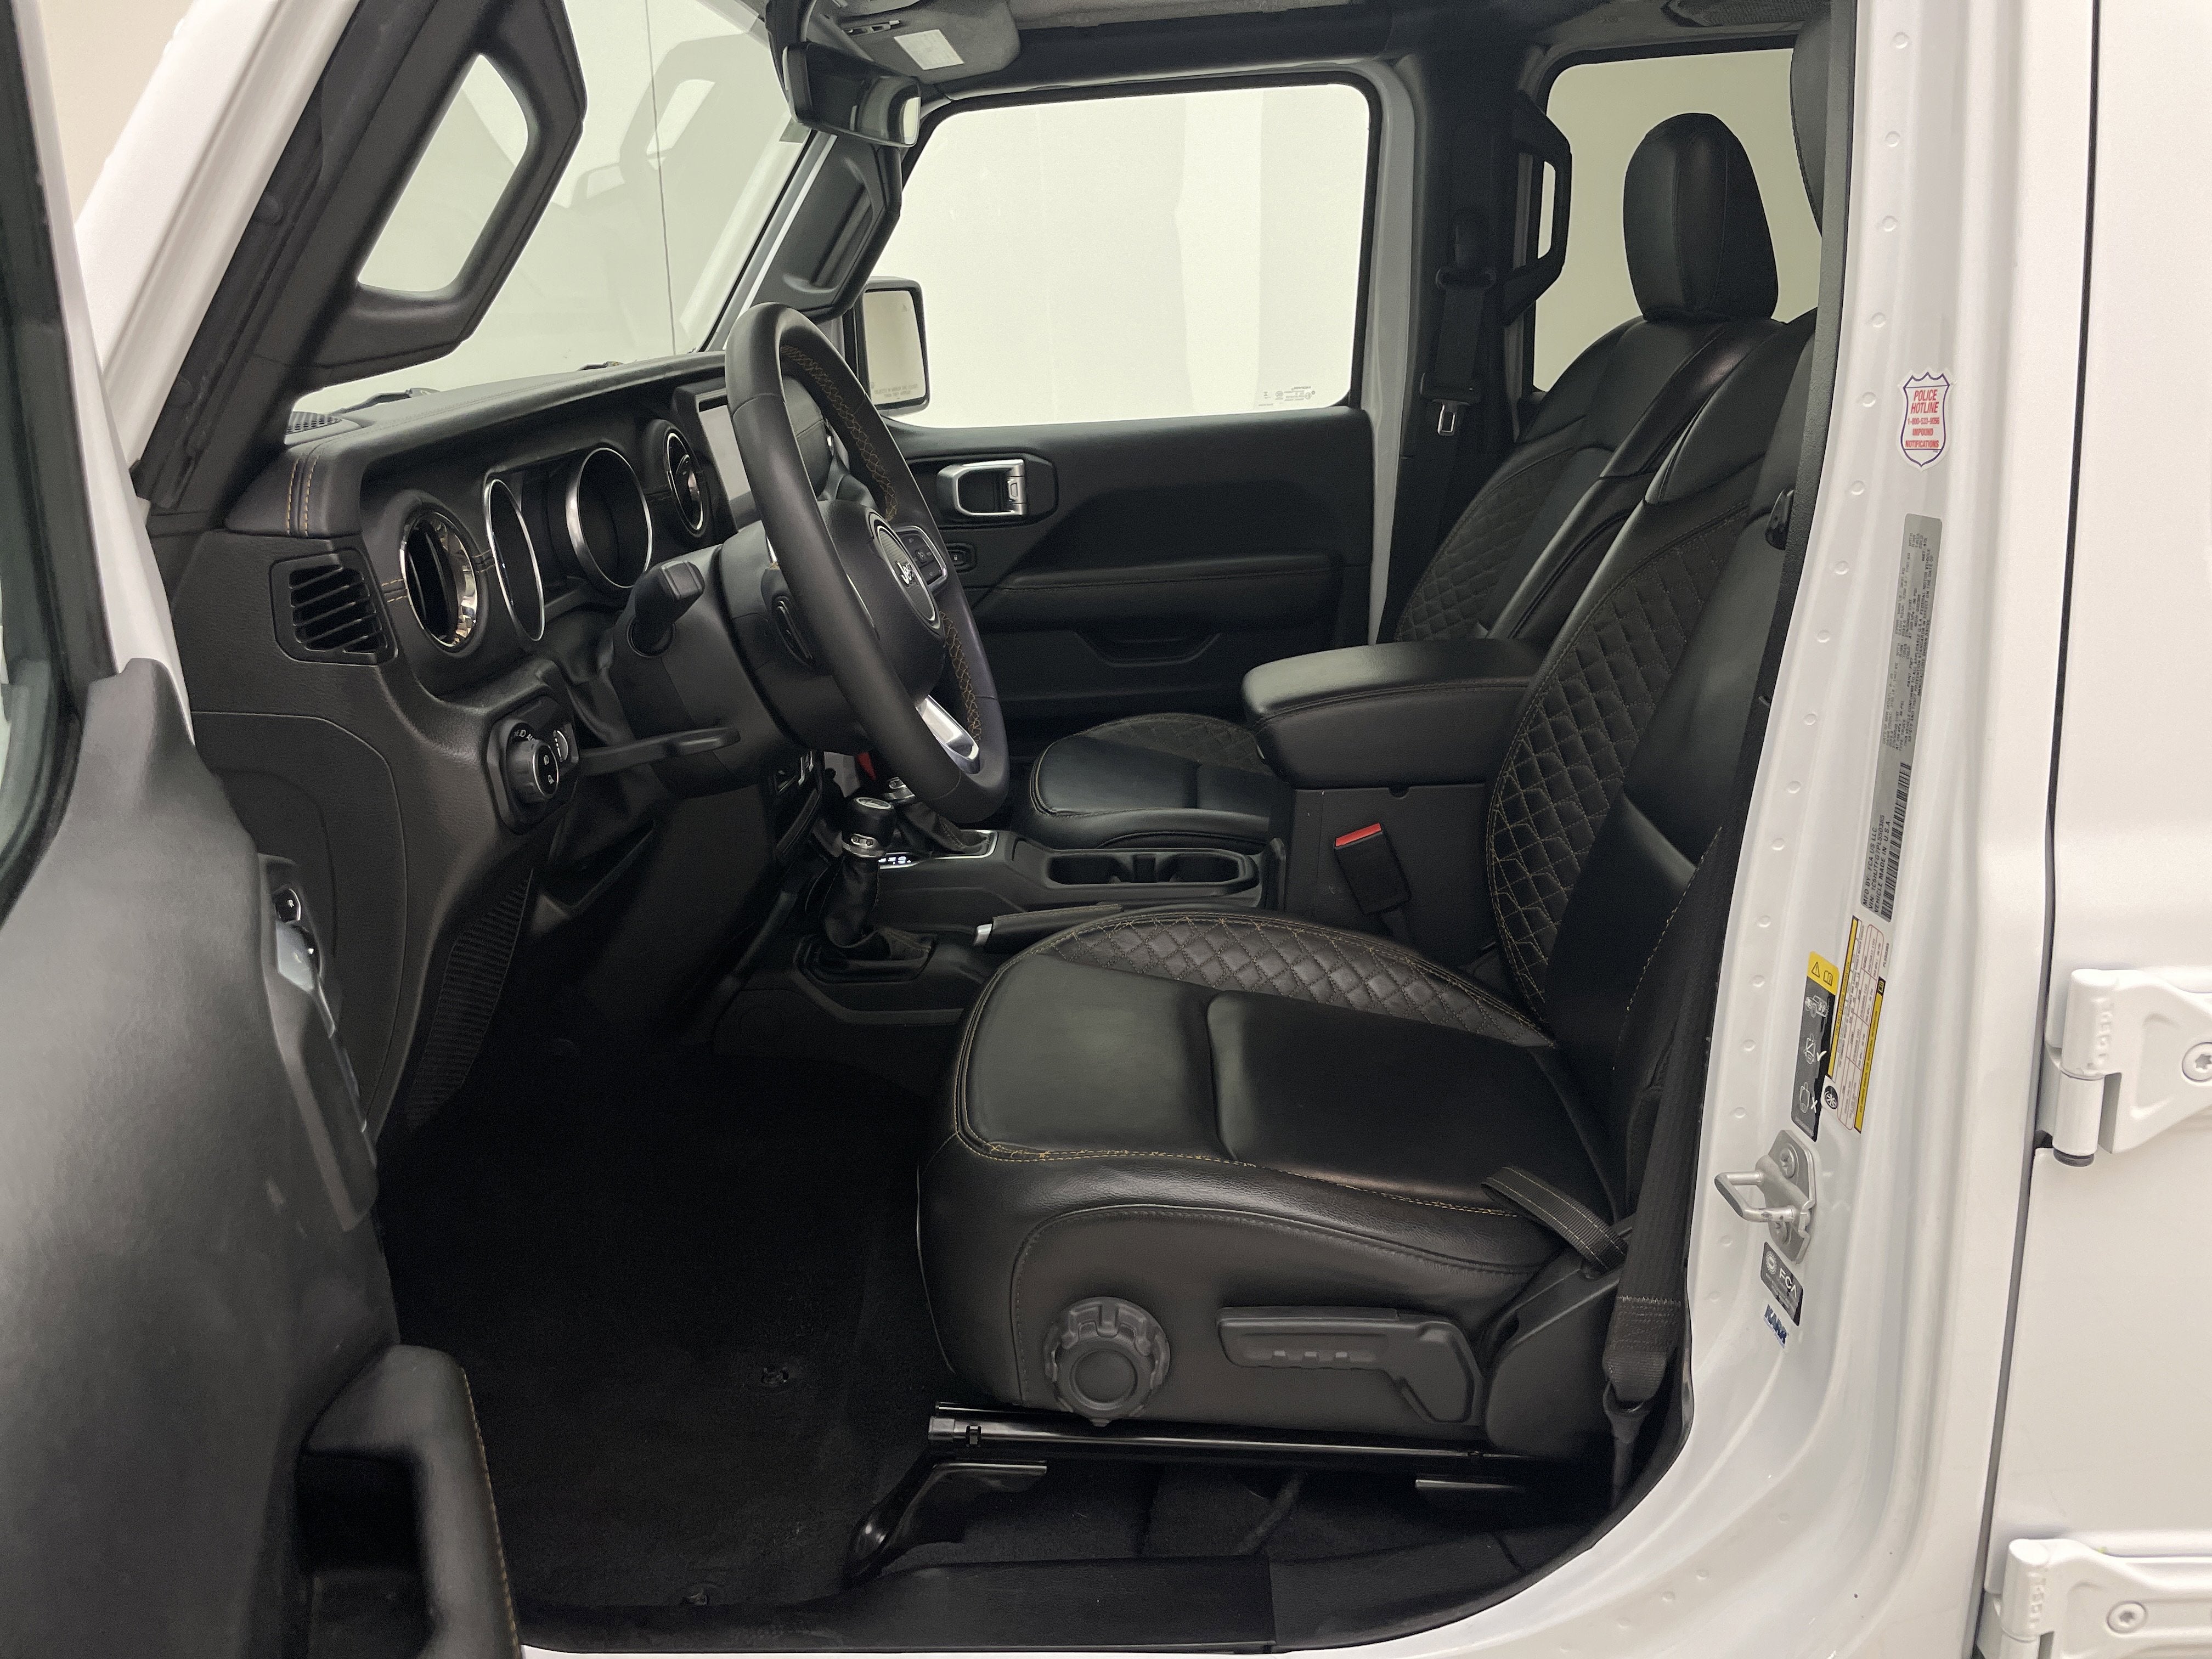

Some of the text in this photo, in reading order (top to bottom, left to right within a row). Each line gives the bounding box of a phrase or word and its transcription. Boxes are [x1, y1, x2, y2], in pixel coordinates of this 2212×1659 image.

[1914, 390, 1938, 401] POLICE
[1910, 402, 1939, 414] HOTLINE
[1869, 843, 1875, 854] US
[1874, 882, 1882, 913] VEHICLE
[1882, 846, 1887, 855] IN
[1779, 1267, 1797, 1298] FCA
